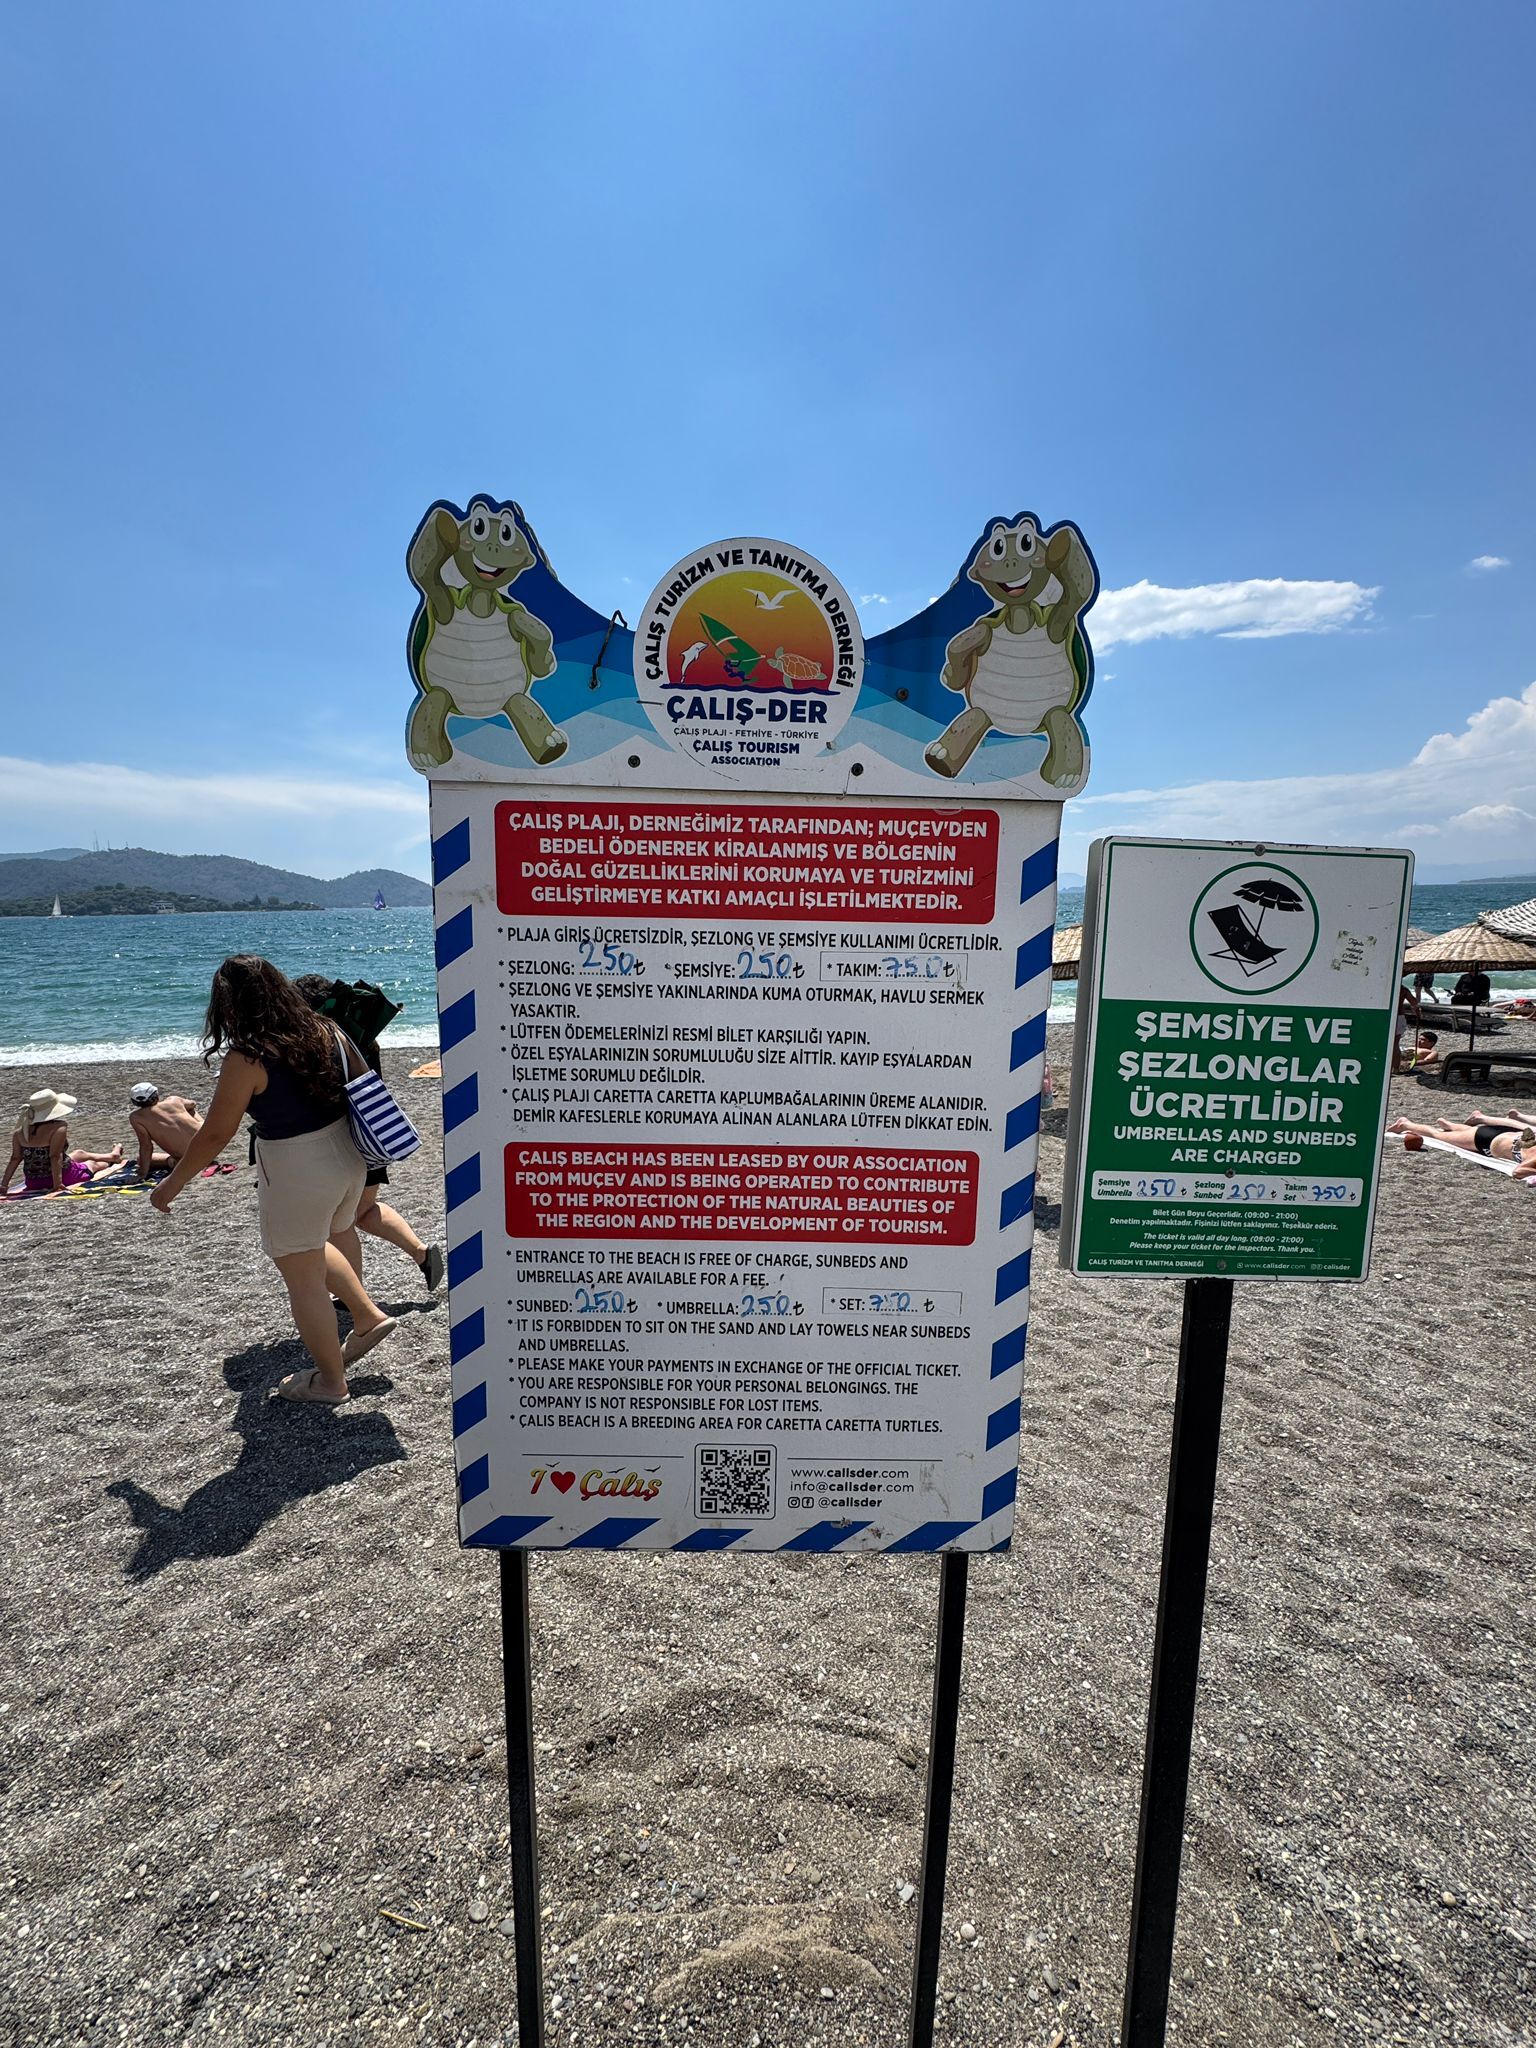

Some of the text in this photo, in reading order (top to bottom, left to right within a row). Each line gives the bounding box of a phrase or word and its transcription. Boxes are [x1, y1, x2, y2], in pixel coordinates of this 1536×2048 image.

[645, 548, 857, 688] ÇALIŞ TURİZM VE TANITMA DERNEĞİ
[666, 695, 827, 725] ÇALIŞ-DER
[702, 728, 726, 736] PLAJI
[735, 728, 772, 738] FETHİYE
[781, 729, 819, 739] TÜRKİYE
[693, 739, 800, 754] ÇALIŞ TOURISM
[711, 756, 780, 766] ASSOCIATION
[509, 812, 987, 839] ÇALIŞ PLAJI, DERNEĞİMİZ TARAFINDAN; MUÇEV'DEN
[539, 835, 956, 862] BEDELİ ÖDENEREK KİRALANMIŞ VE BÖLGENİN
[521, 860, 973, 886] DOĞAL GÜZELLİKLERİNİ KORUMAYA VE TURİZMİNİ
[531, 884, 962, 910] GELİŞTİRMEYE KATKI AMAÇLI İŞLETİLMEKTEDİR.
[507, 926, 1002, 951] PLAJA GİRİŞ ÜCRETSİZDİR, ŞEZLONG VE ŞEMSİYE KULLANIMI ÜCRETLİDİR.
[508, 961, 574, 976] ŞEZLONG:
[674, 961, 735, 979] ŞEMSİYE:
[836, 963, 882, 977] TAKIM:
[510, 1022, 870, 1045] LÜTFEN ÖDEMELERİNİZİ RESMİ BİLET KARŞILIĞI YAPIN.
[1135, 1009, 1353, 1045] ŞEMSİYE VE
[512, 1065, 704, 1083] İŞLETME SORUMLU DEĞİLDİR.
[1117, 1051, 1362, 1084] ŞEZLONGLAR
[512, 1088, 987, 1111] ÇALIŞ PLAJI CARETTA CARETTA KAPLUMBAĞALARININ ÜREME ALANIDIR.
[1129, 1085, 1344, 1123] ÜCRETLİDİR
[1113, 1125, 1357, 1147] UMBRELLAS AND SUNBEDS
[518, 1151, 967, 1172] ÇALIŞ BEACH HAS BEEN LEASED BY OUR ASSOCIATION
[1170, 1148, 1301, 1165] ARE CHARGED
[1097, 1189, 1133, 1197] Umbrella
[1193, 1191, 1223, 1199] Sunbed
[1110, 1217, 1140, 1225] Denetim
[1171, 1209, 1186, 1217] Gün
[1187, 1210, 1206, 1218] Boyu
[1244, 1211, 1270, 1219] (09:00
[1275, 1212, 1299, 1220] 21:00)
[1129, 1241, 1153, 1249] Please
[1154, 1242, 1172, 1250] keep
[1212, 1243, 1223, 1251] for
[1224, 1243, 1236, 1251] the
[1278, 1245, 1299, 1253] Thank
[515, 1250, 908, 1269] ENTRANCE TO THE BEACH IS FREE OF CHARGE, SUNBEDS AND
[516, 1300, 572, 1313] SUNBED:
[666, 1302, 739, 1315] UMBRELLA:
[839, 1298, 866, 1311] SET:
[518, 1338, 629, 1352] AND UMBRELLAS.
[519, 1414, 942, 1432] ÇALIS BEACH IS A BREEDING AREA FOR CARETTA CARETTA TURTLES.
